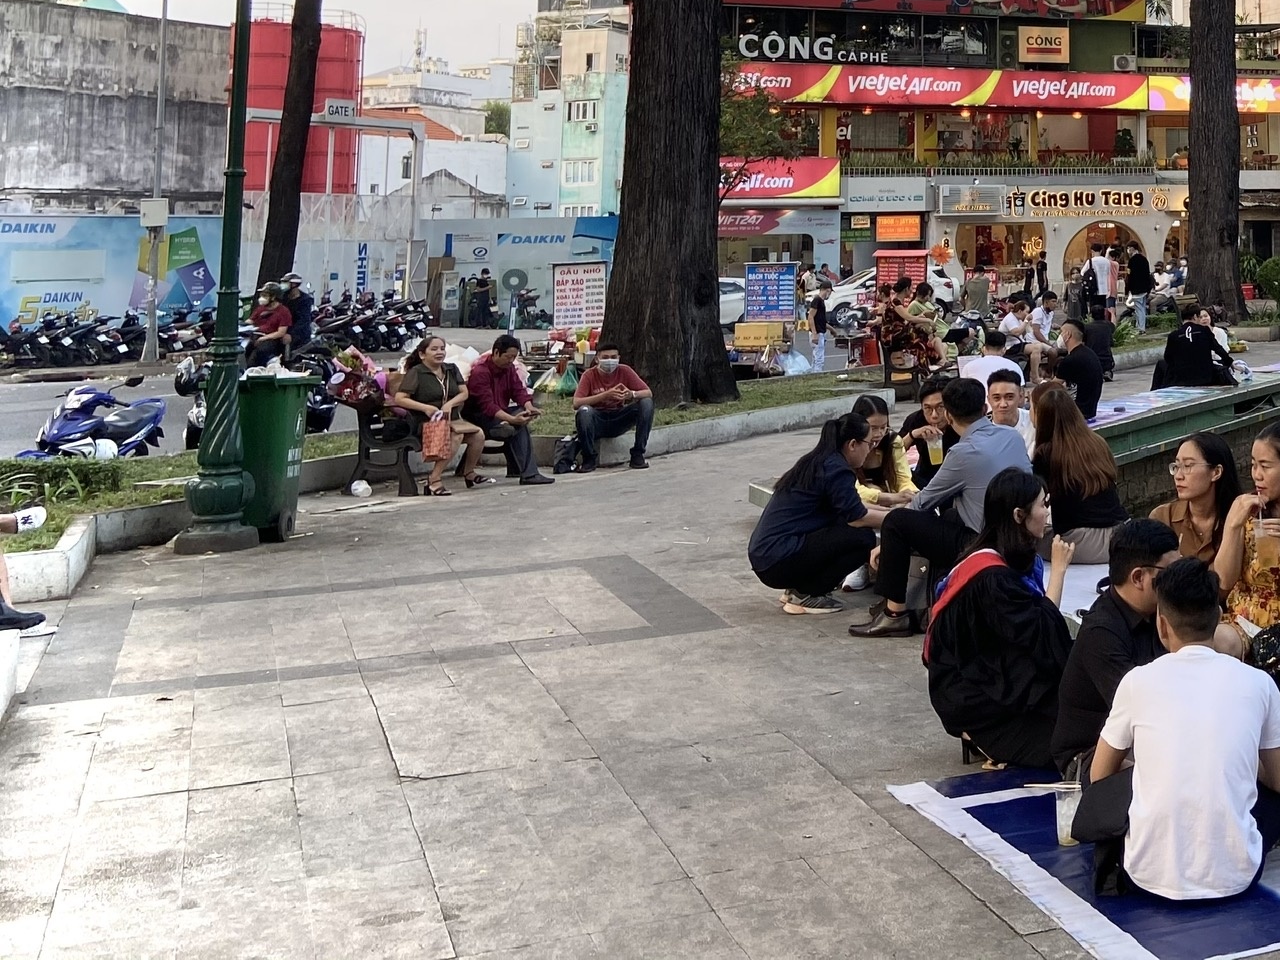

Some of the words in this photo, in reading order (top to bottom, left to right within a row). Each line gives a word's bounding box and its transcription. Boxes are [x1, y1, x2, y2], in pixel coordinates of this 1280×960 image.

[738, 30, 834, 61] CỘNG
[1026, 33, 1062, 48] CỘNG
[328, 105, 349, 117] GATE
[351, 106, 355, 117] 1
[1029, 189, 1070, 209] Cing
[1072, 189, 1096, 207] Hu
[1100, 189, 1145, 208] Tang
[1, 222, 56, 234] DAIKIN
[511, 234, 566, 245] DAIKIN
[942, 238, 949, 248] 8
[43, 292, 83, 304] DAIKIN
[19, 296, 42, 325] 5
